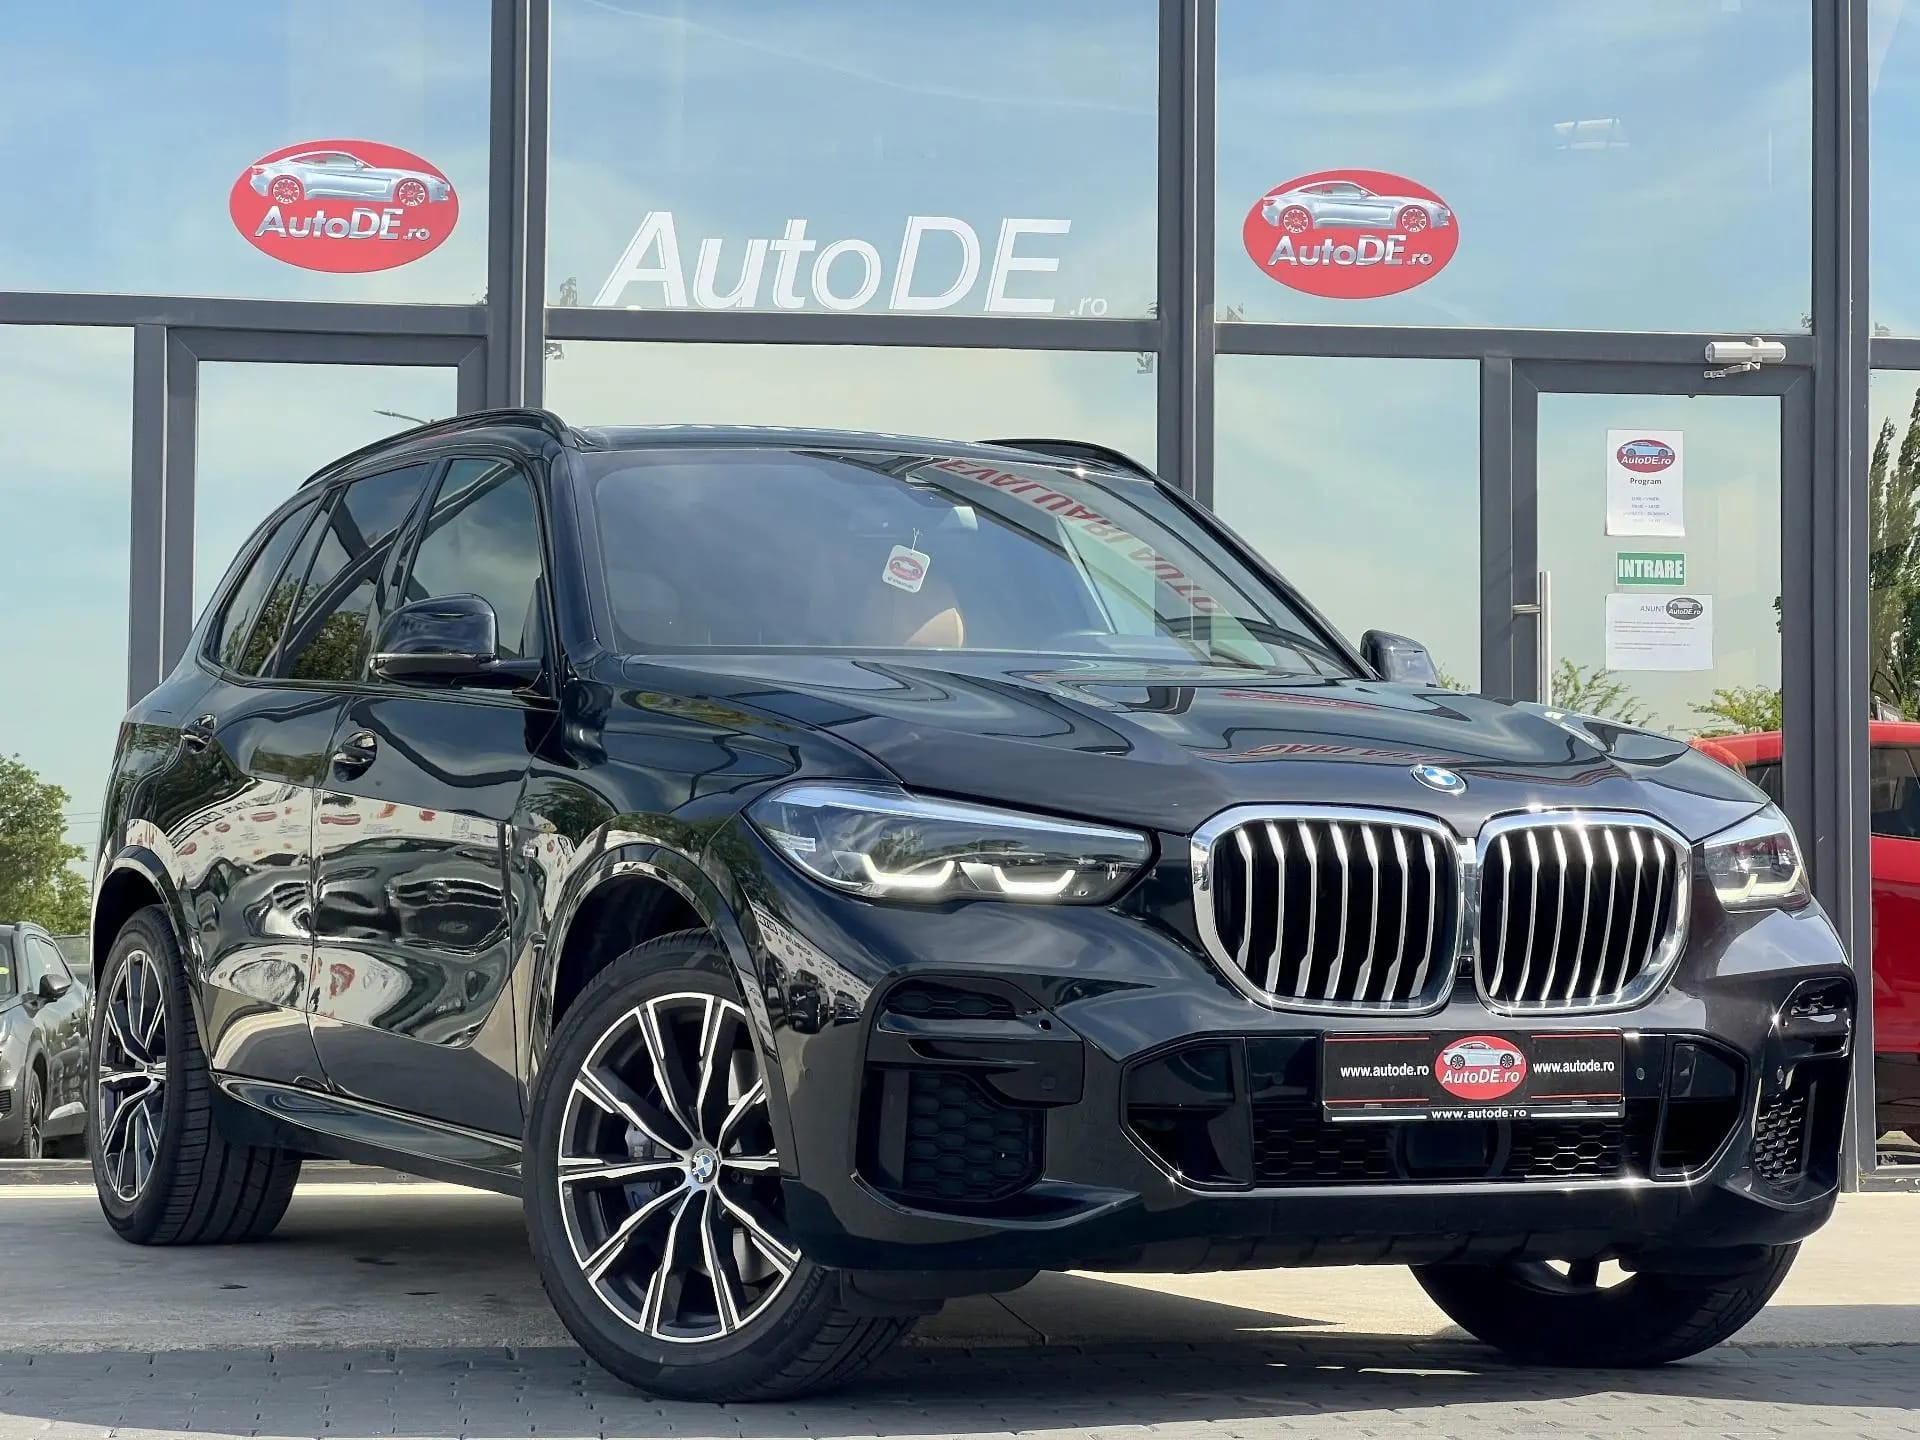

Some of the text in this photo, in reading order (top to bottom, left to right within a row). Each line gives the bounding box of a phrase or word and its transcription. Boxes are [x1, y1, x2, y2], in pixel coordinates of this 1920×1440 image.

[1621, 456, 1672, 465] AutoDE.ro
[1630, 477, 1662, 486] Program
[1618, 559, 1684, 579] INTRARE
[1340, 1062, 1430, 1078] www.autode.ro
[1532, 1060, 1615, 1074] www.autode.ro
[1441, 1068, 1520, 1085] AutoDE.ro
[1431, 1108, 1527, 1120] www.autode.ro
